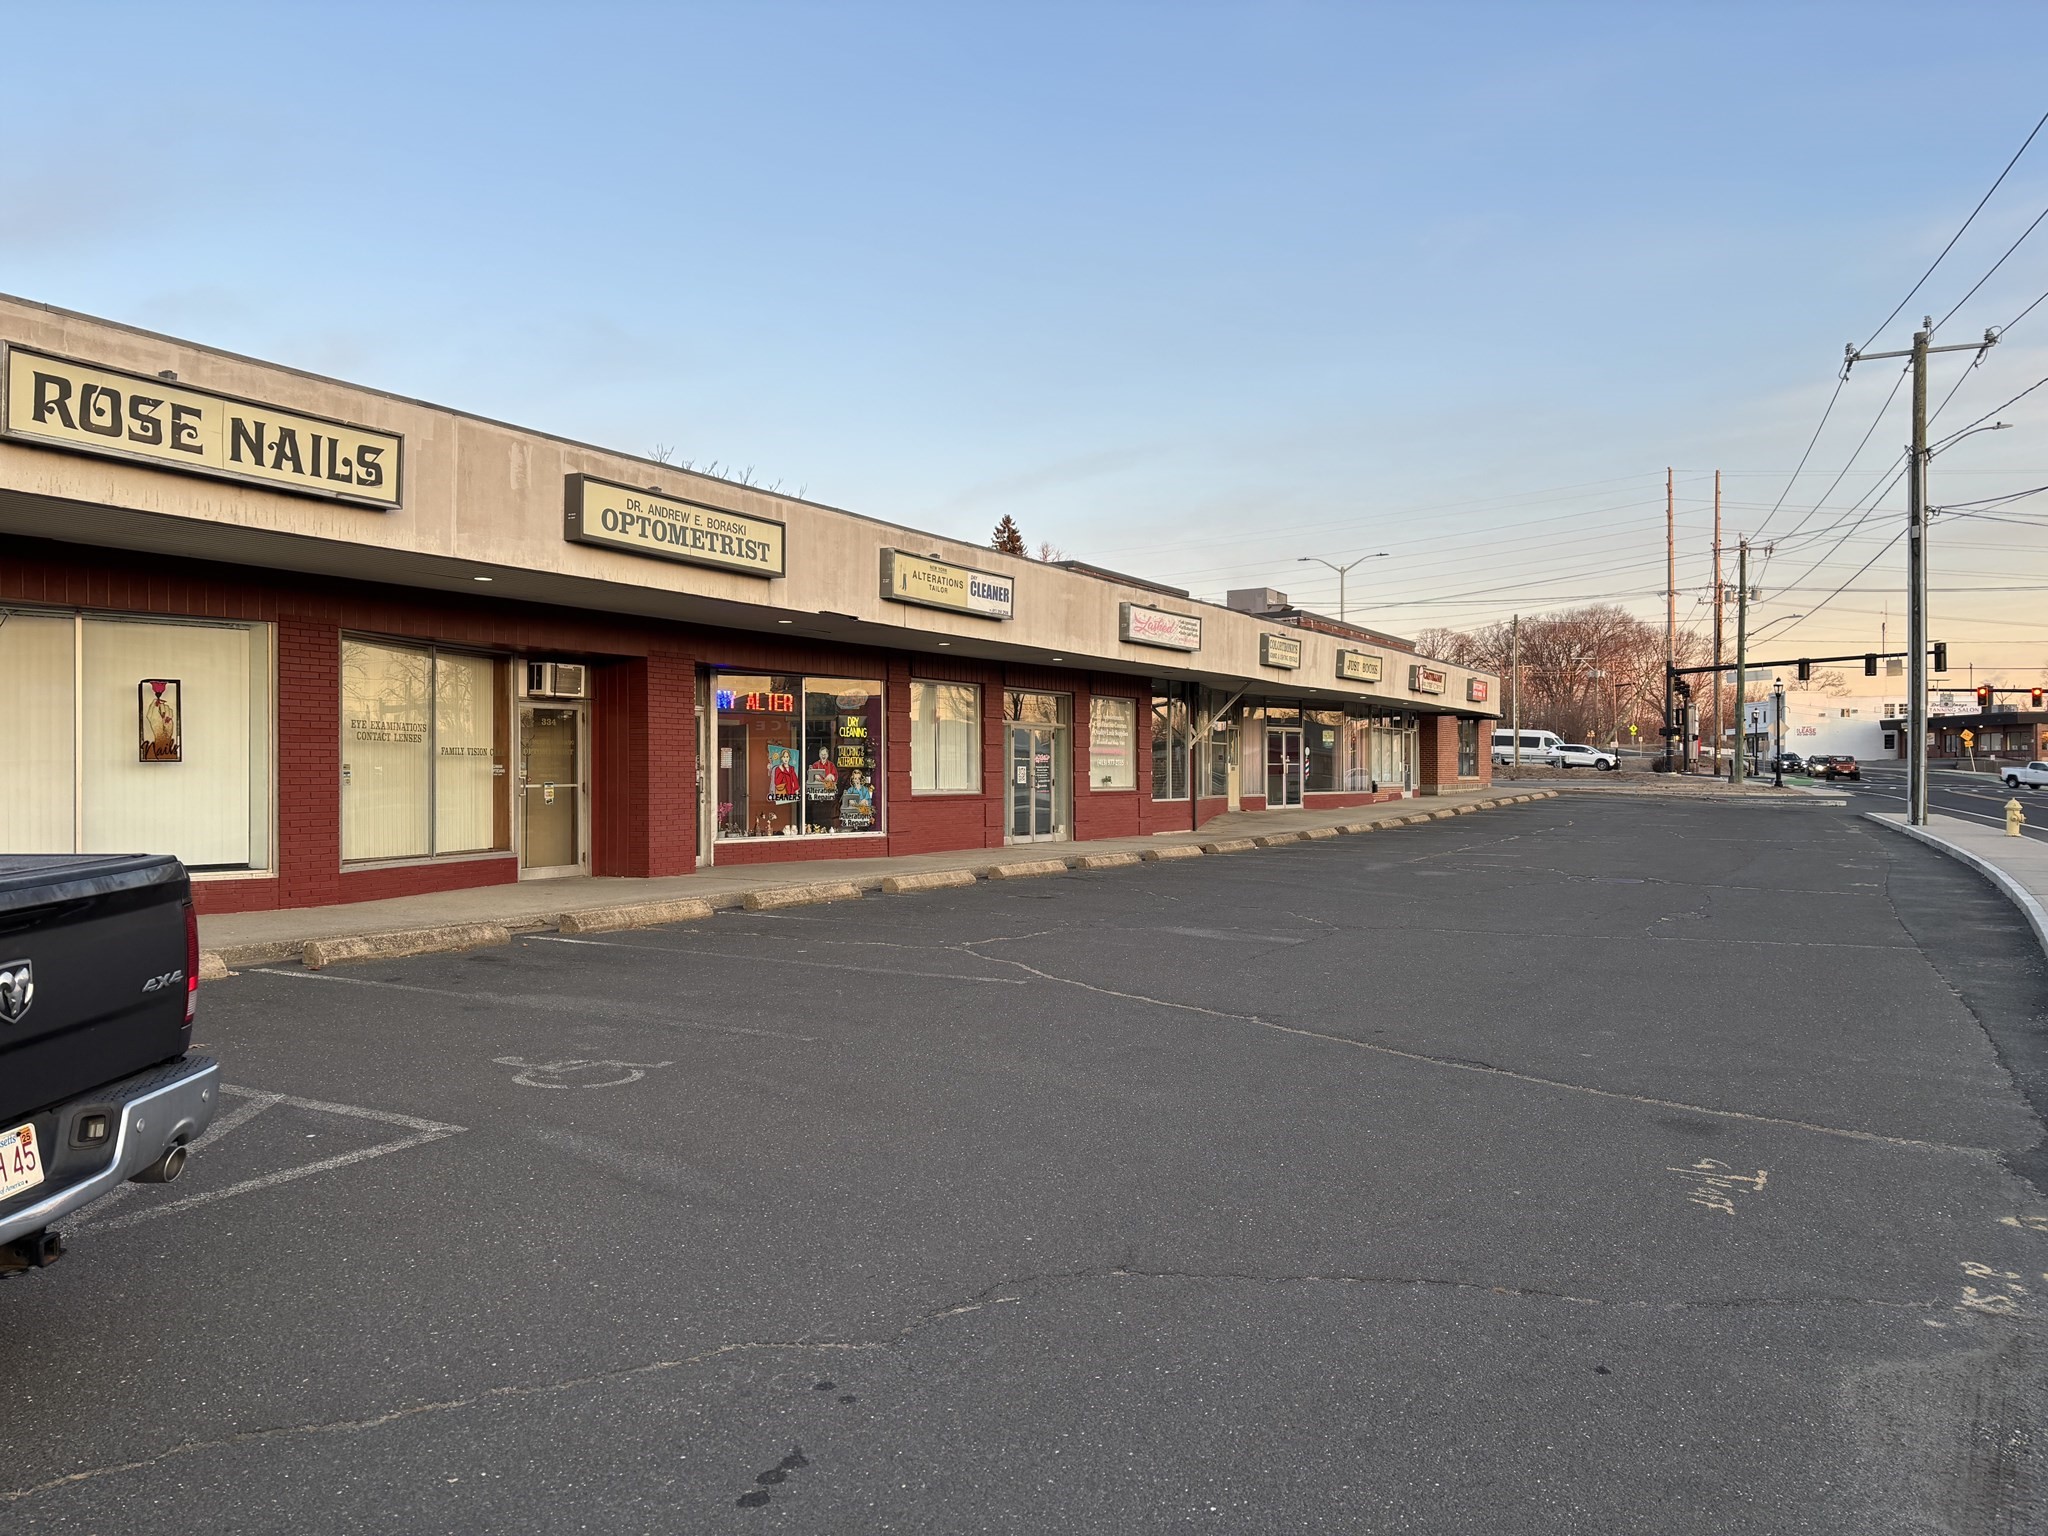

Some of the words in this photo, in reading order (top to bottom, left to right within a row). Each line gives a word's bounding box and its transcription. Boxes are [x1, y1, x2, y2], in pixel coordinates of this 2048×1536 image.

[32, 371, 204, 456] ROSE
[229, 417, 385, 489] NAILS
[626, 498, 643, 513] DR.
[647, 503, 690, 524] ANDREW
[694, 515, 703, 527] E.
[707, 517, 747, 536] BORASKI
[601, 508, 770, 563] OPTOMETRIST
[912, 570, 964, 590] ALTERATIONS
[929, 584, 948, 594] TAILOR
[970, 581, 1010, 603] CLEANER
[1347, 660, 1360, 672] JUST
[746, 691, 793, 712] ALTER
[351, 719, 367, 729] EYE
[370, 720, 427, 732] EXAMINATIONS
[541, 718, 557, 726] 334
[847, 716, 860, 727] DRY
[356, 731, 391, 742] CONTACT
[393, 733, 422, 743] LENSES
[839, 726, 868, 738] CLEANING
[140, 738, 180, 761] Nails
[441, 746, 465, 756] FAMILY
[467, 747, 488, 756] VISION
[767, 793, 801, 801] CLEANERS
[21, 1133, 31, 1143] 25
[5, 1180, 25, 1193] America
